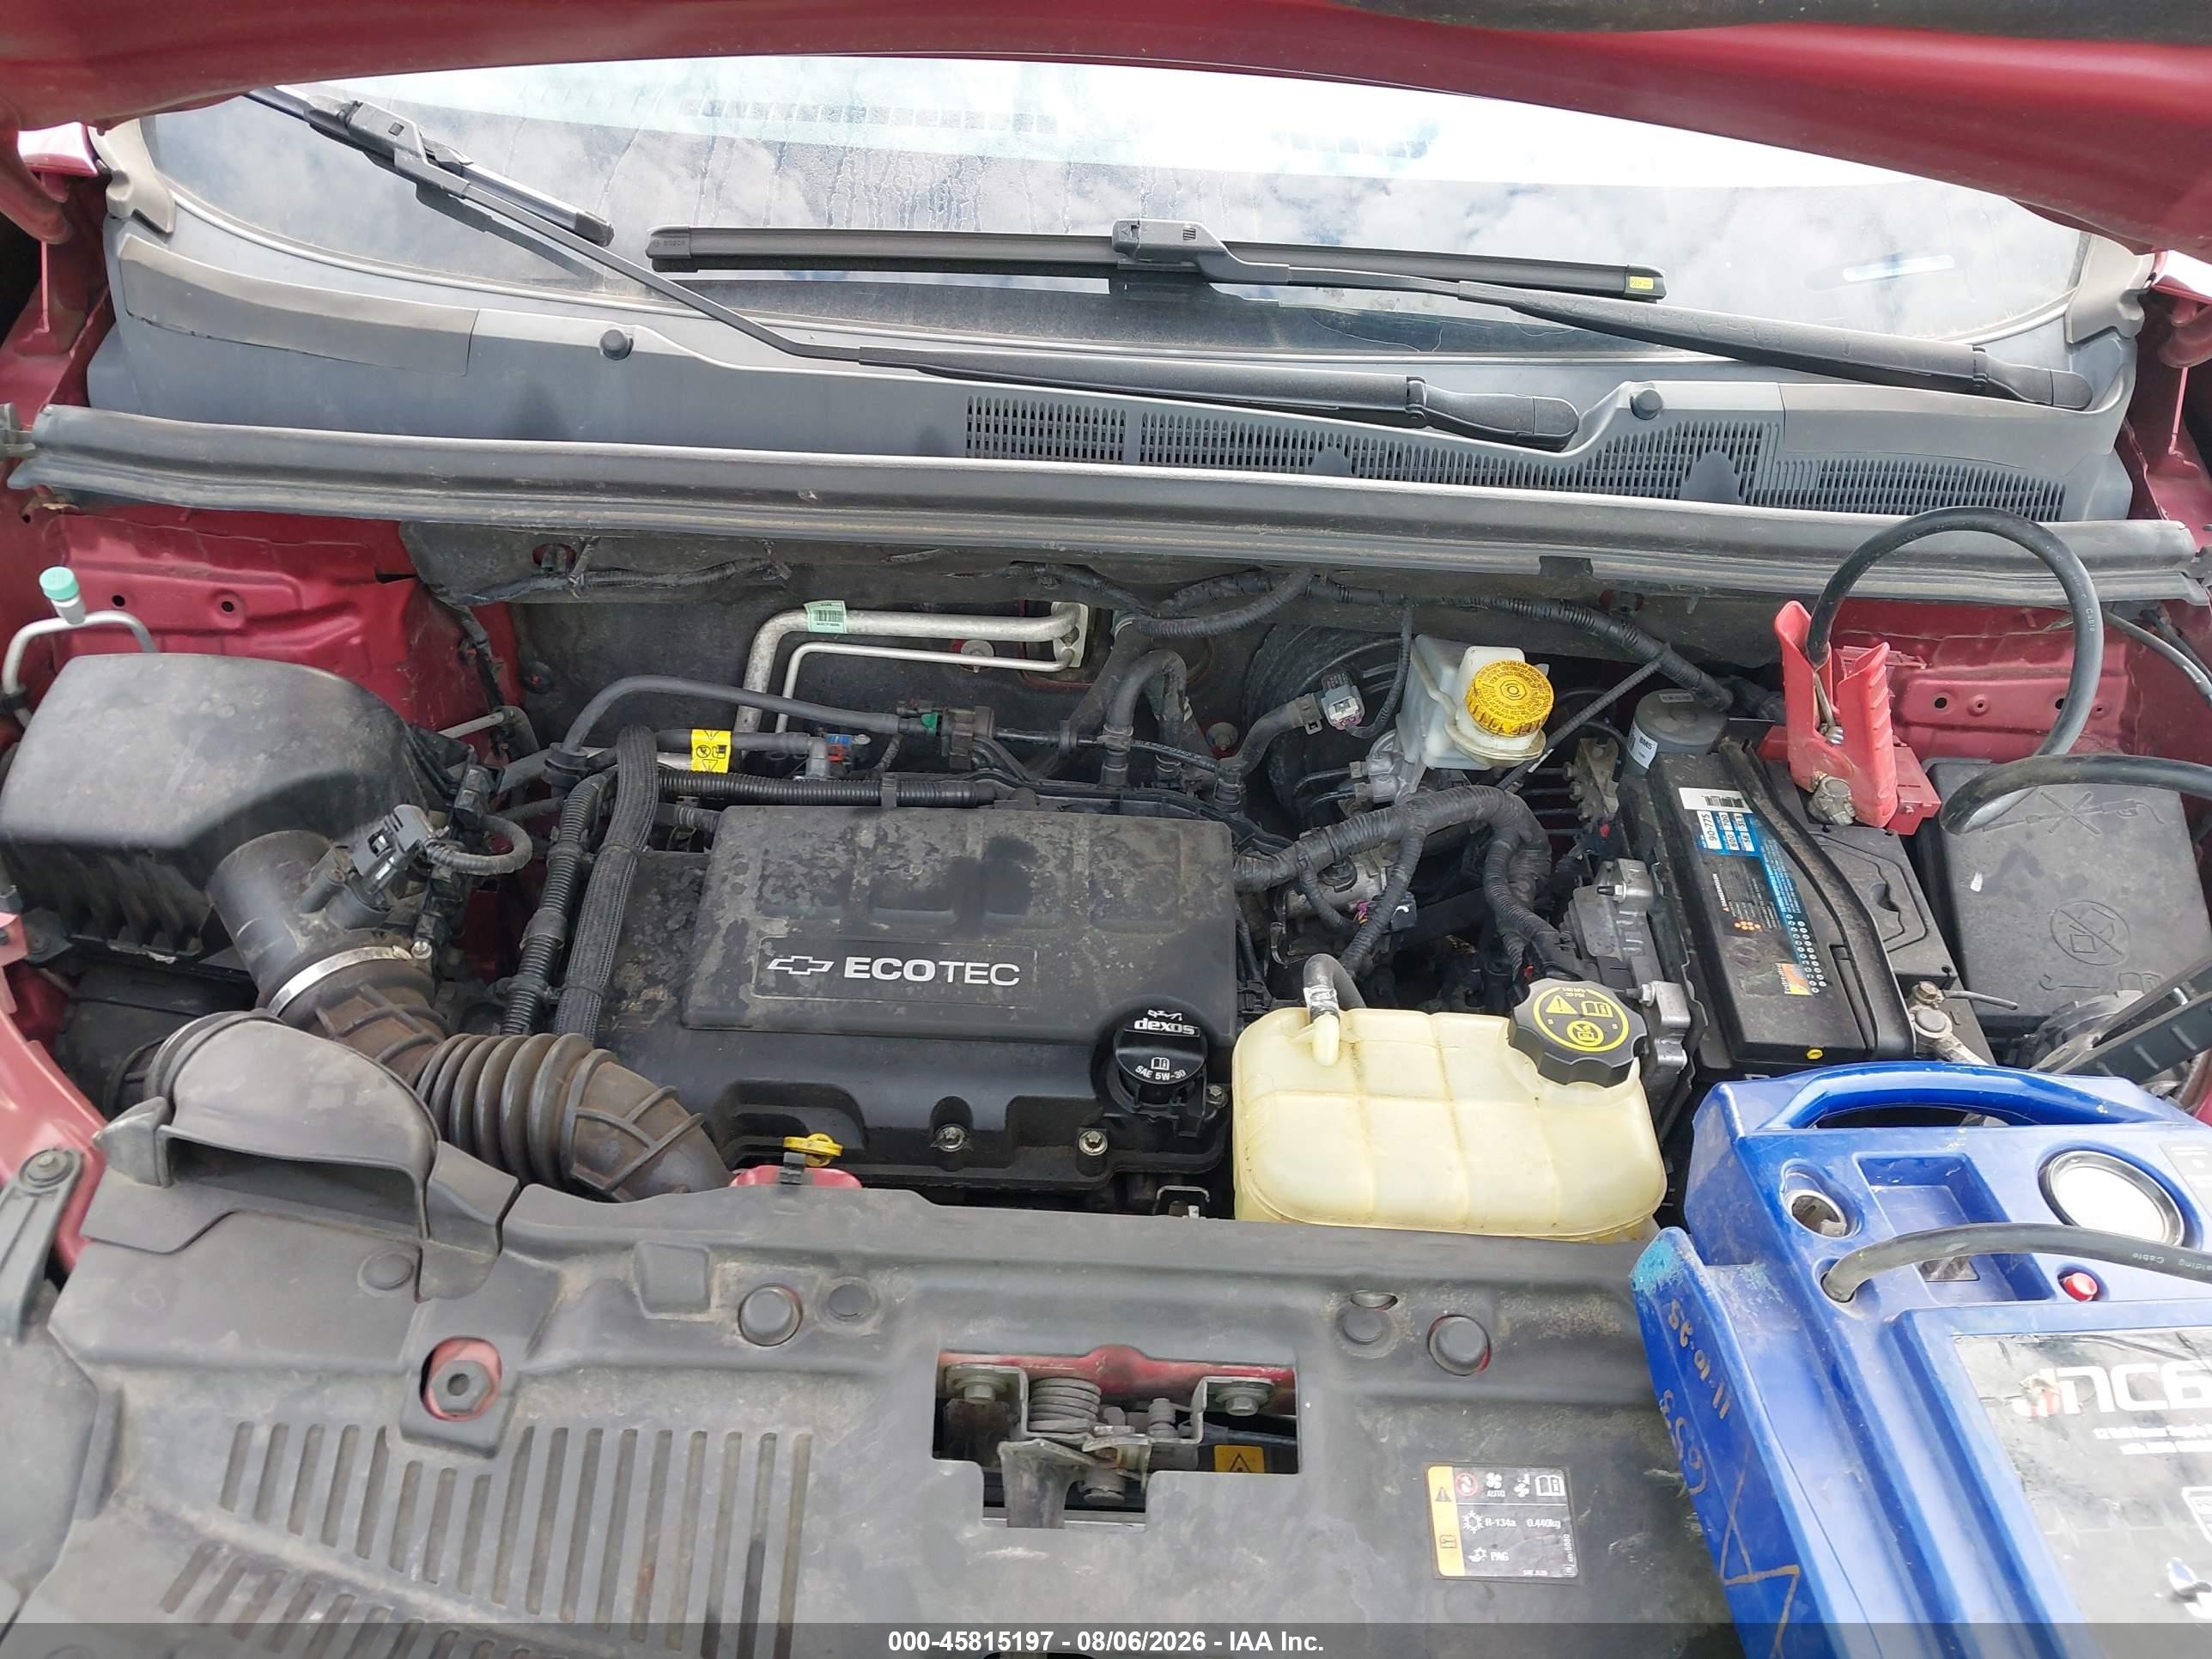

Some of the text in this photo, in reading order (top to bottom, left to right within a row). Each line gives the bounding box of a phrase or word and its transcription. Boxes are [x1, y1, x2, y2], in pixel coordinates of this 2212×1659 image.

[844, 956, 1021, 987] ECOTEC
[1133, 1017, 1196, 1036] dexos
[1134, 1065, 1187, 1081] SAE 5W-30
[2132, 1252, 2212, 1271] elding Cable
